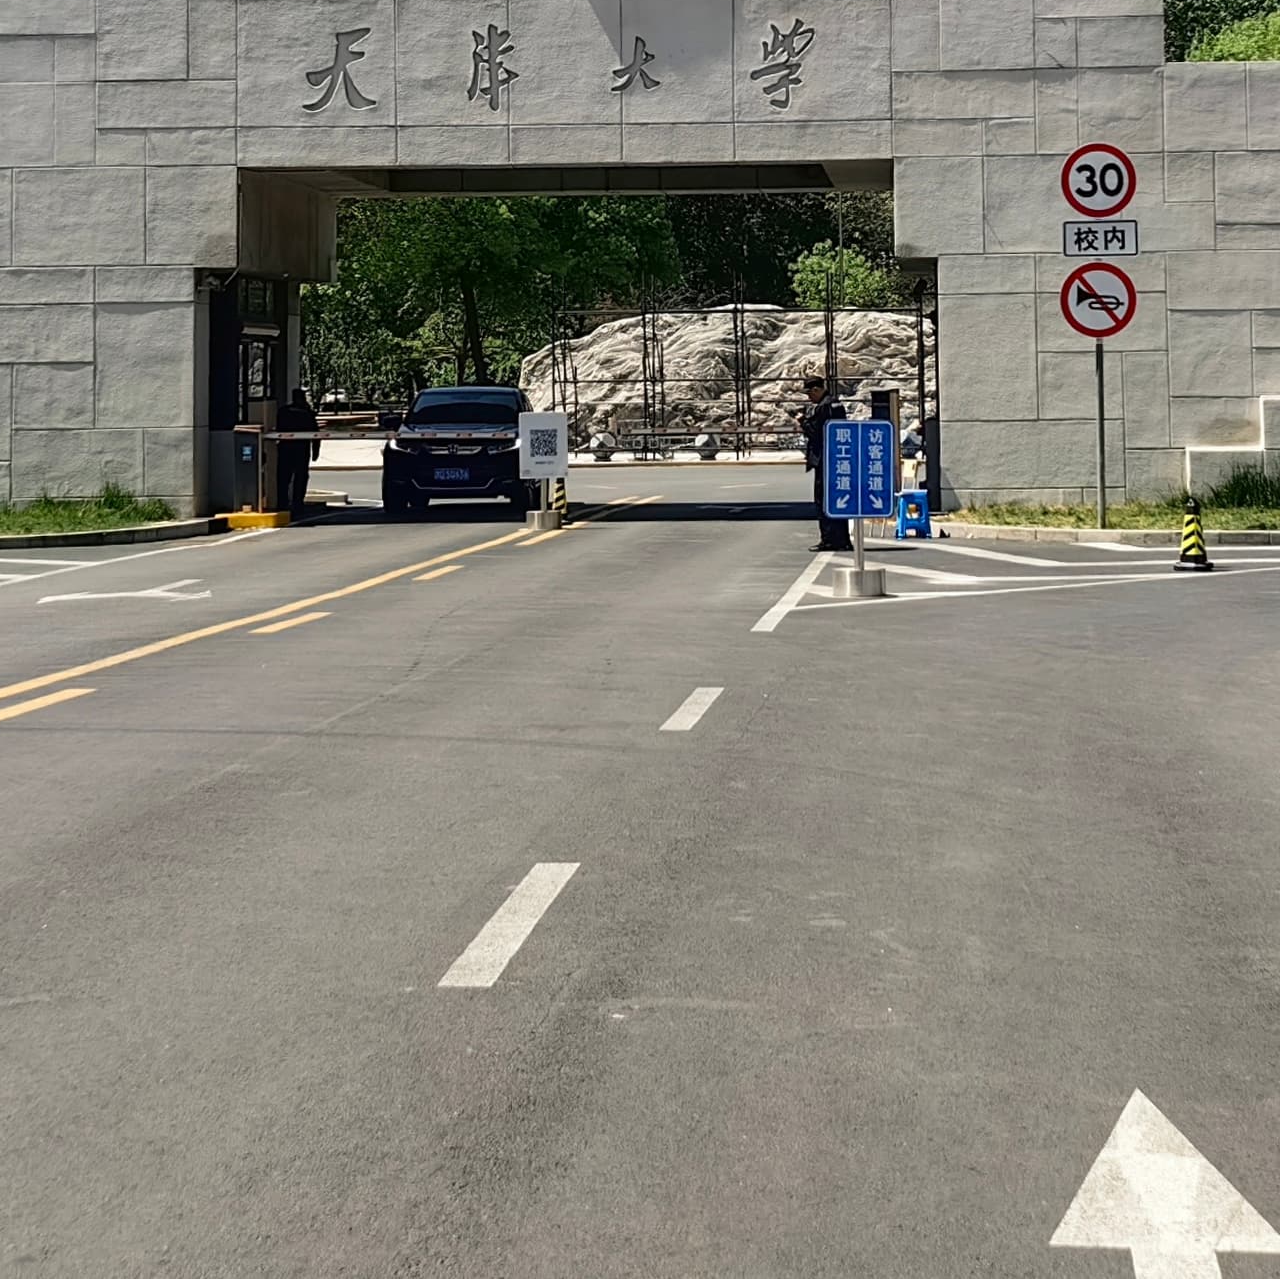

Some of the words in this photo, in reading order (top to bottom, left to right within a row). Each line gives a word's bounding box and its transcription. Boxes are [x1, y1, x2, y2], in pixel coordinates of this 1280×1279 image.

[1075, 162, 1124, 198] 30
[1074, 226, 1125, 252] 校内
[835, 428, 852, 491] 职工通道
[868, 428, 884, 491] 访客通道
